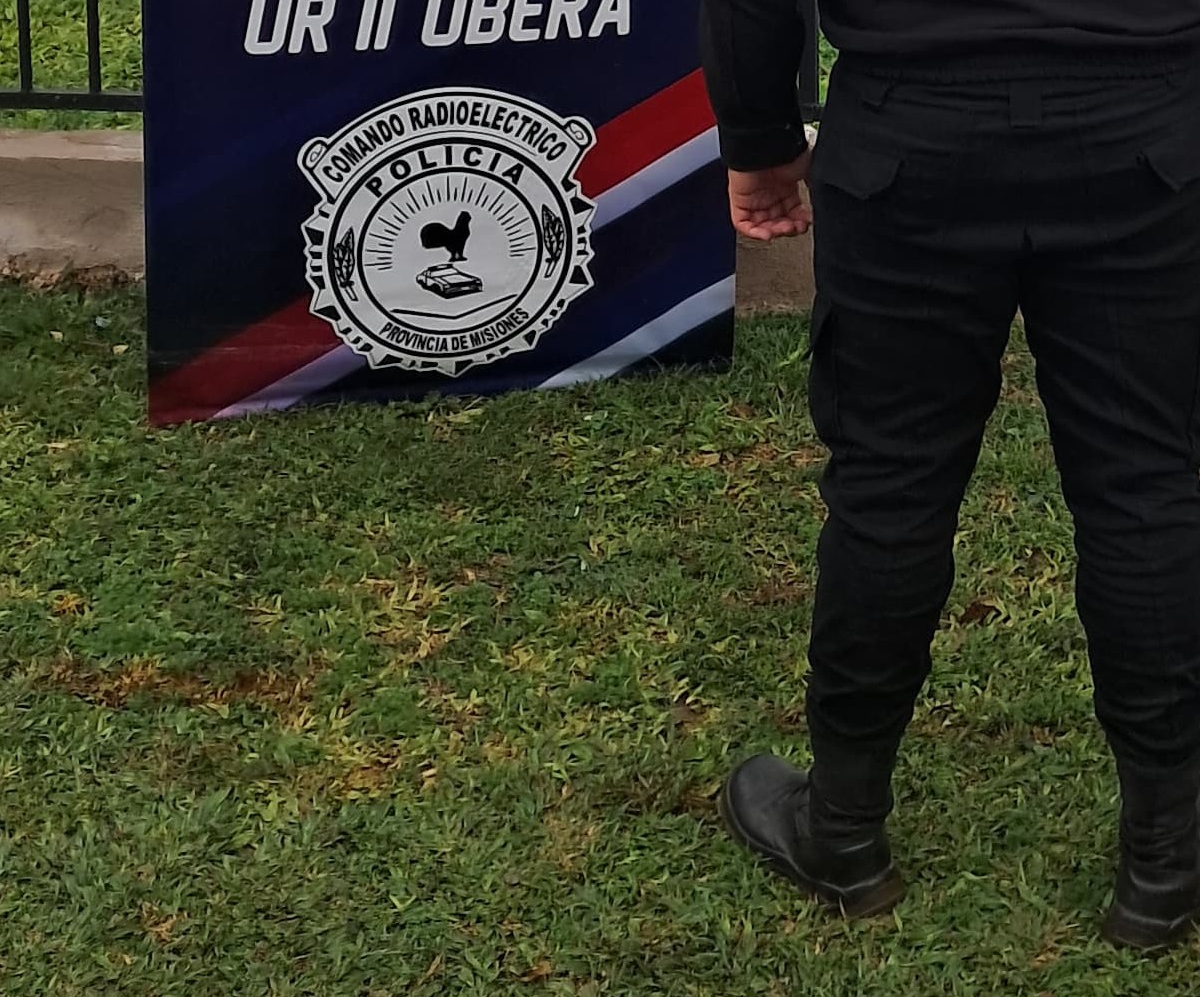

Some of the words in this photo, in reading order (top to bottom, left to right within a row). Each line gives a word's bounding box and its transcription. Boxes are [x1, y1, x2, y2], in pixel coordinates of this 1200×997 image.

[322, 112, 405, 184] COMANDO
[408, 100, 568, 162] RADIOELECTRICO
[365, 145, 524, 198] POLICIA
[379, 321, 449, 352] PROVINCIA
[451, 335, 468, 351] DE
[470, 306, 530, 348] MISIONES
